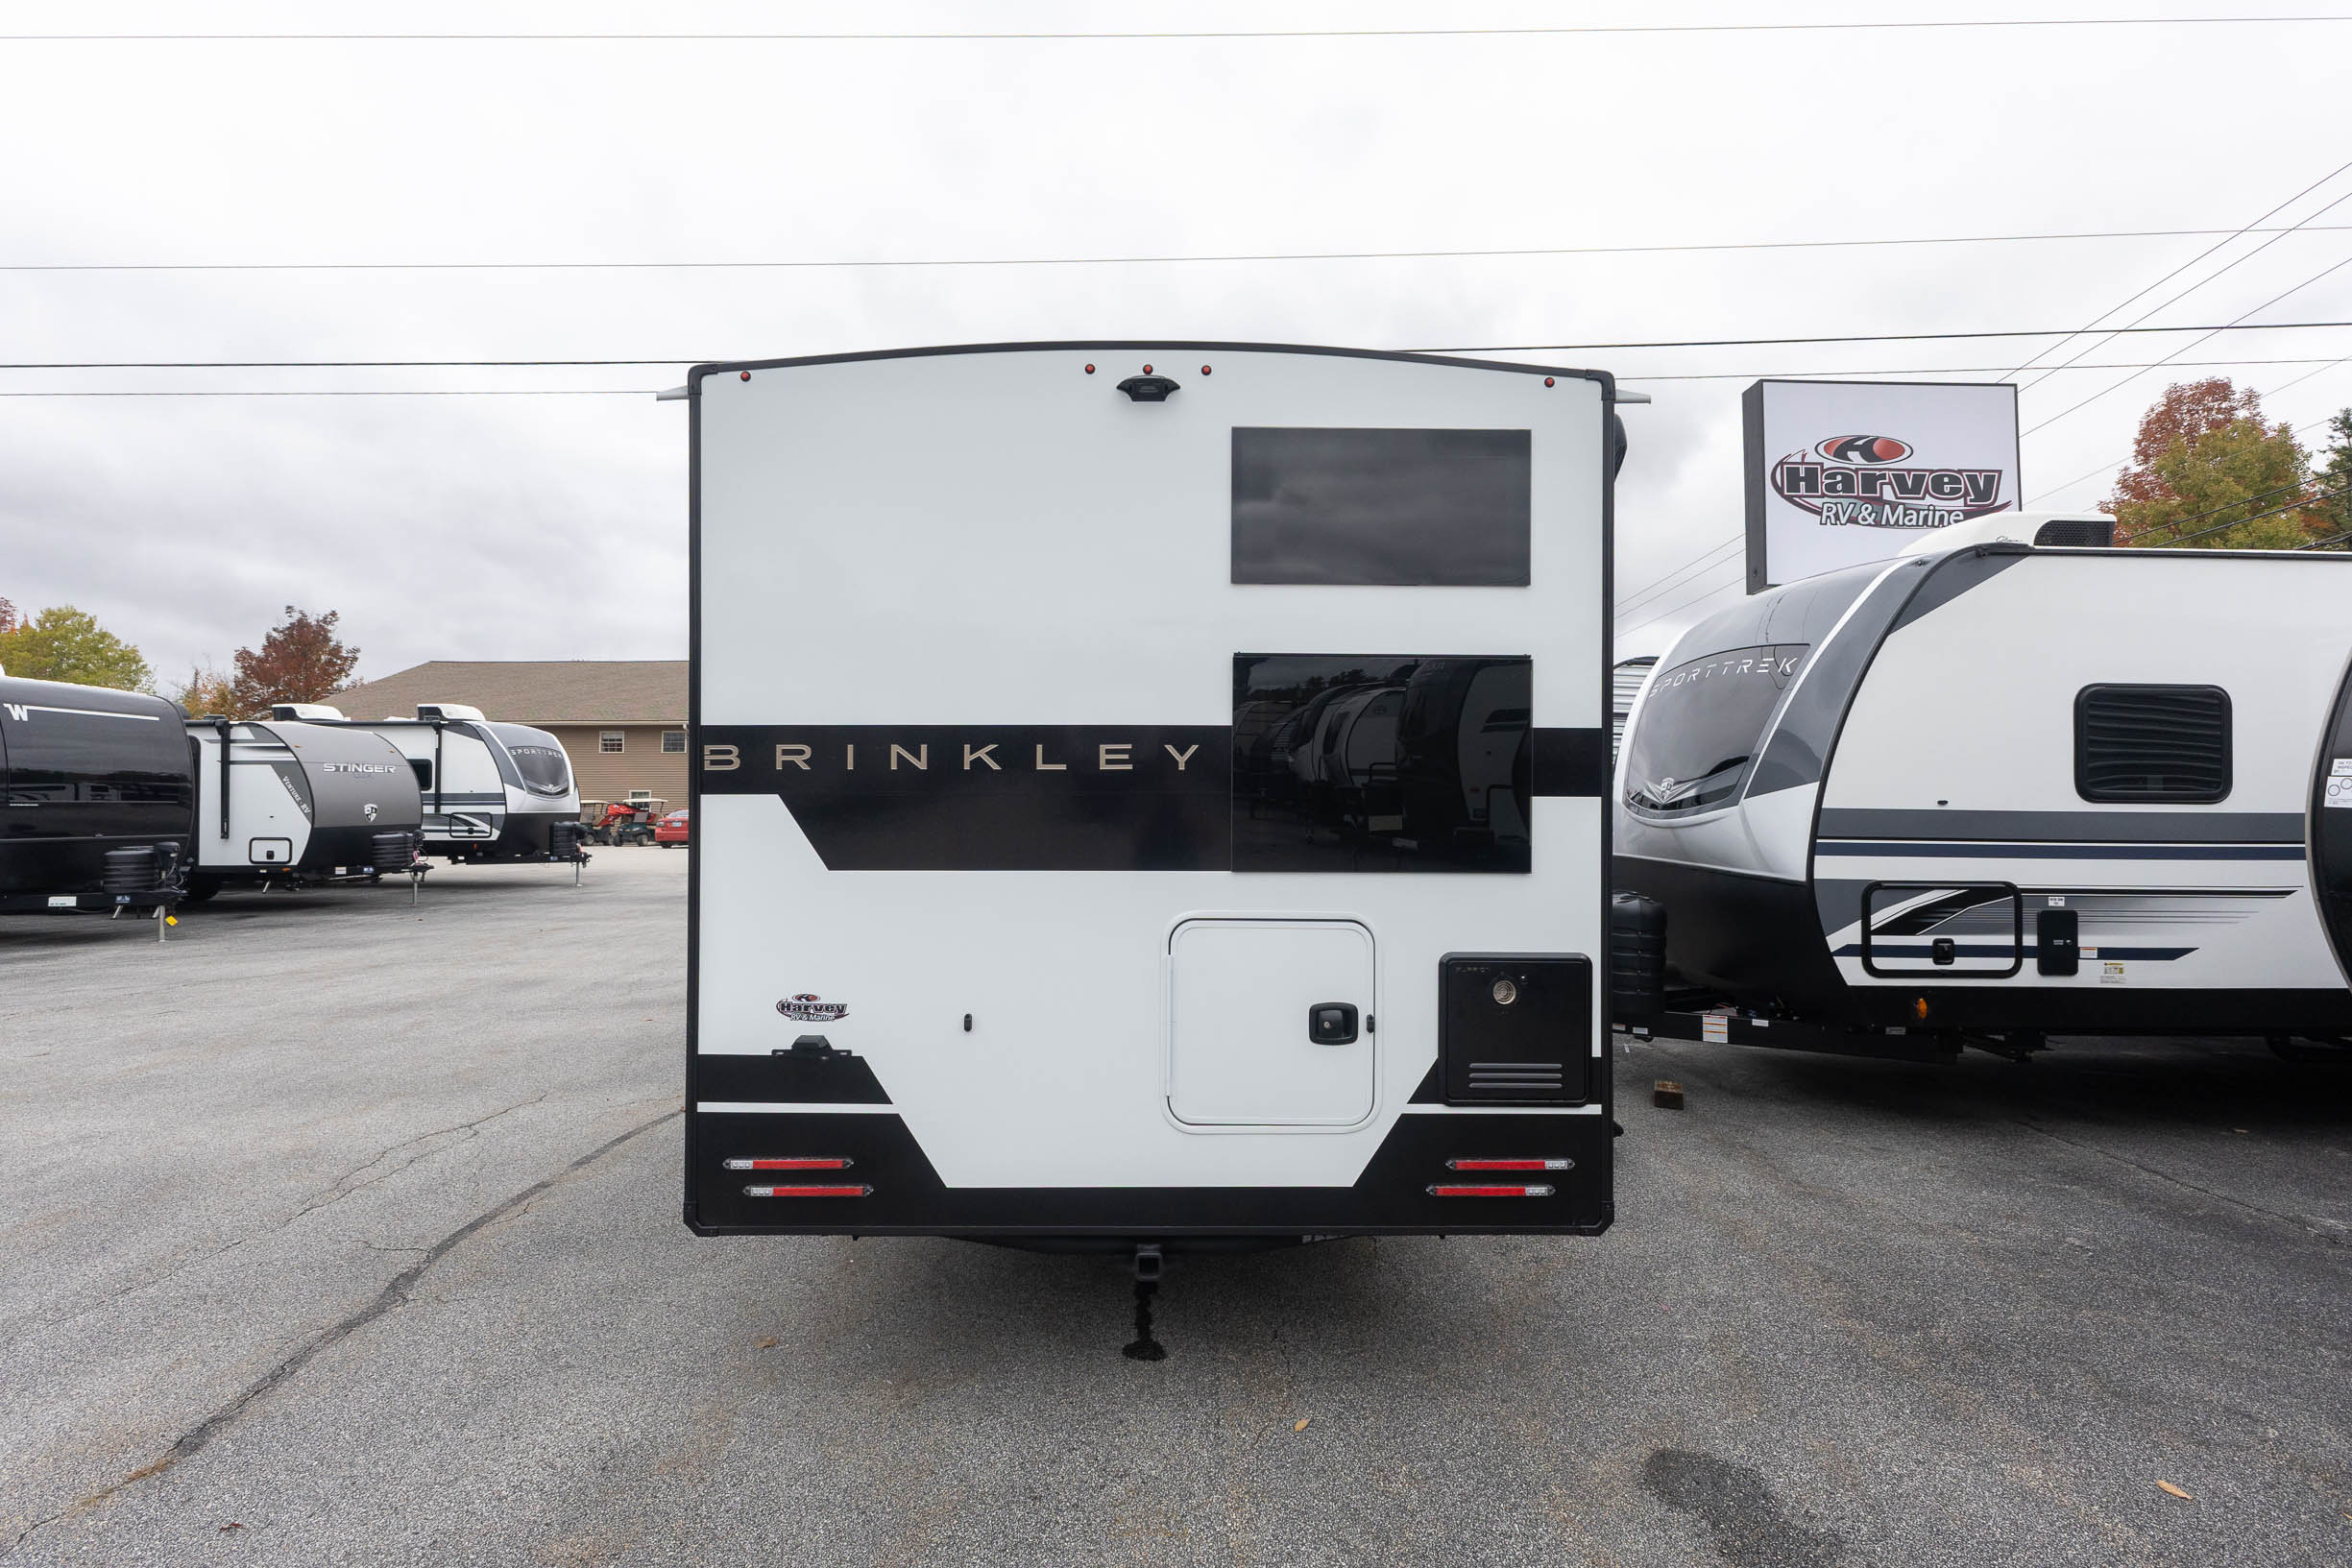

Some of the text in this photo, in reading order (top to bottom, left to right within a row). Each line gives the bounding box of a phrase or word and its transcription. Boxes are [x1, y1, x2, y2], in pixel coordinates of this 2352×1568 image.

[1781, 463, 2002, 506] Harvey
[1821, 502, 1965, 527] RV & Marine
[1650, 658, 1798, 697] SPORTTREK
[3, 703, 29, 722] W
[323, 762, 396, 773] STINGER
[703, 743, 1200, 771] BRINKLEY
[282, 775, 311, 813] VENTURE RV
[779, 1001, 847, 1015] Harvey
